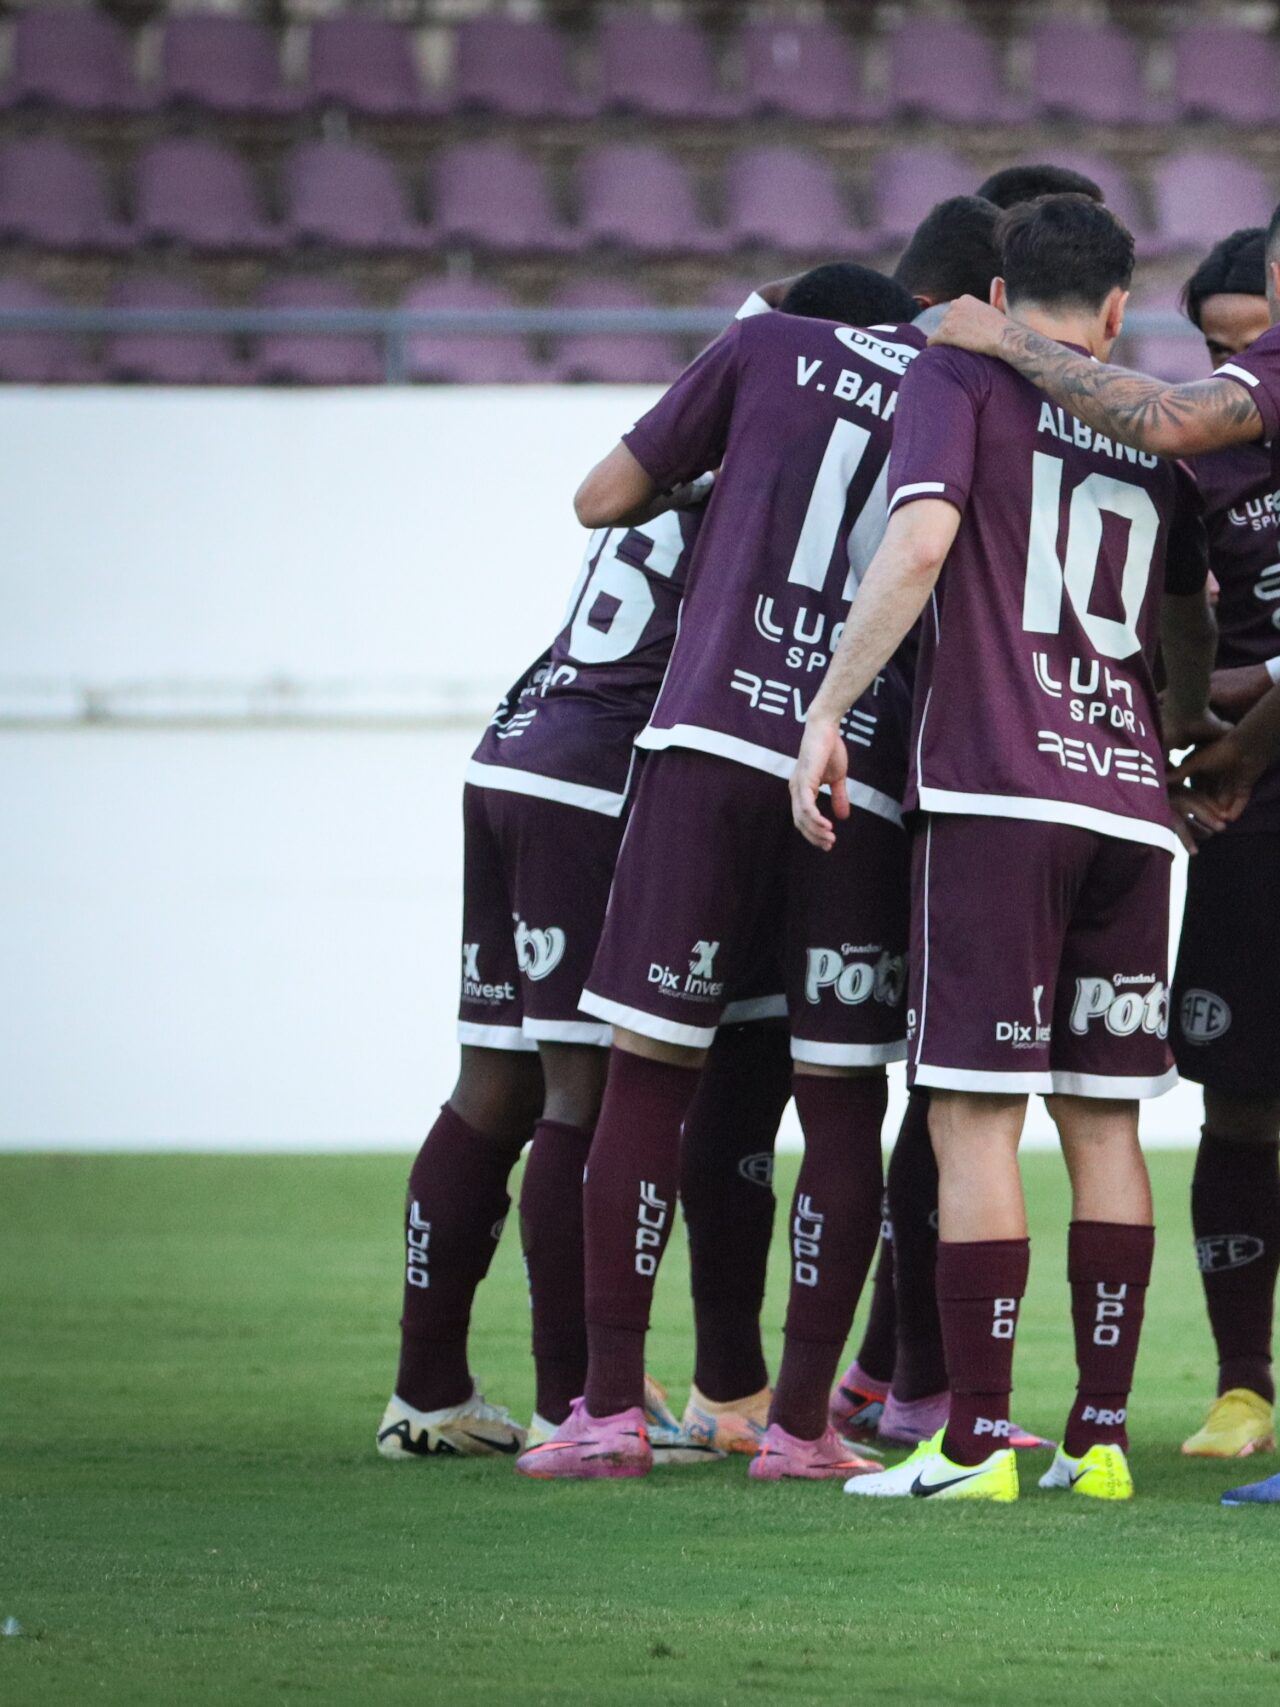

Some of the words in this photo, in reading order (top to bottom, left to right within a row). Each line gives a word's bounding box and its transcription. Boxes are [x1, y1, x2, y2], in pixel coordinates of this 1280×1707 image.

[1023, 451, 1160, 660] 10
[648, 963, 680, 989] Dix
[995, 1021, 1032, 1042] Dix
[1082, 1405, 1127, 1426] PRO
